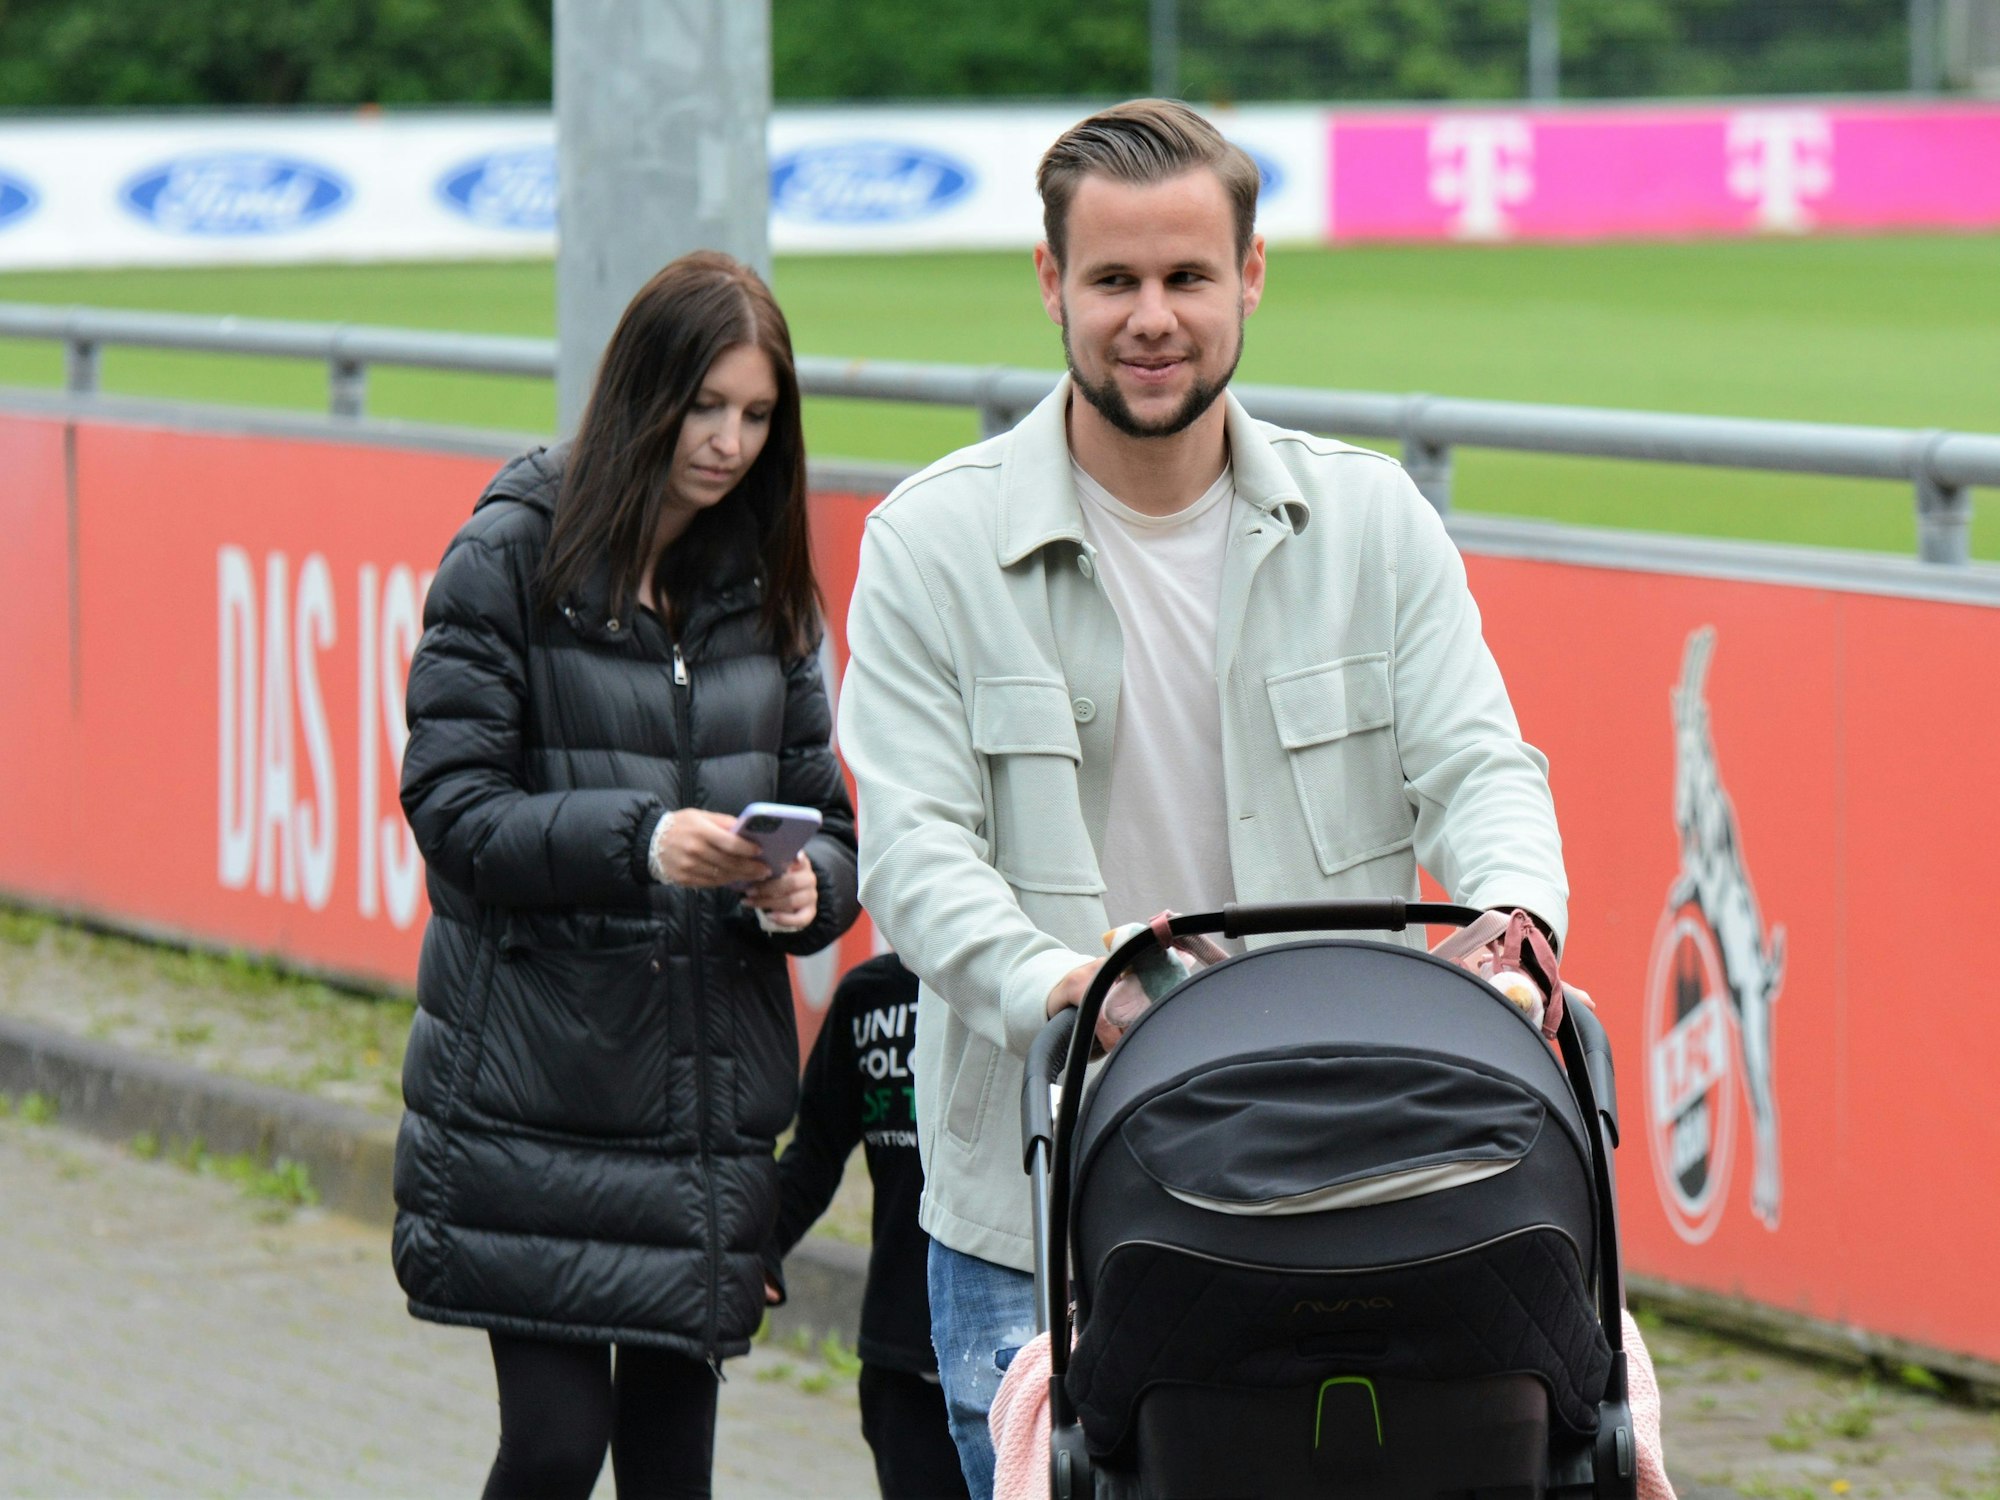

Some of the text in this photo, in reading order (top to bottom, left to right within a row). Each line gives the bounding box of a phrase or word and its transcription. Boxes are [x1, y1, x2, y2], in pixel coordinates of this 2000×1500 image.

[217, 544, 436, 931] DAS IS
[1292, 1296, 1394, 1313] nuna
